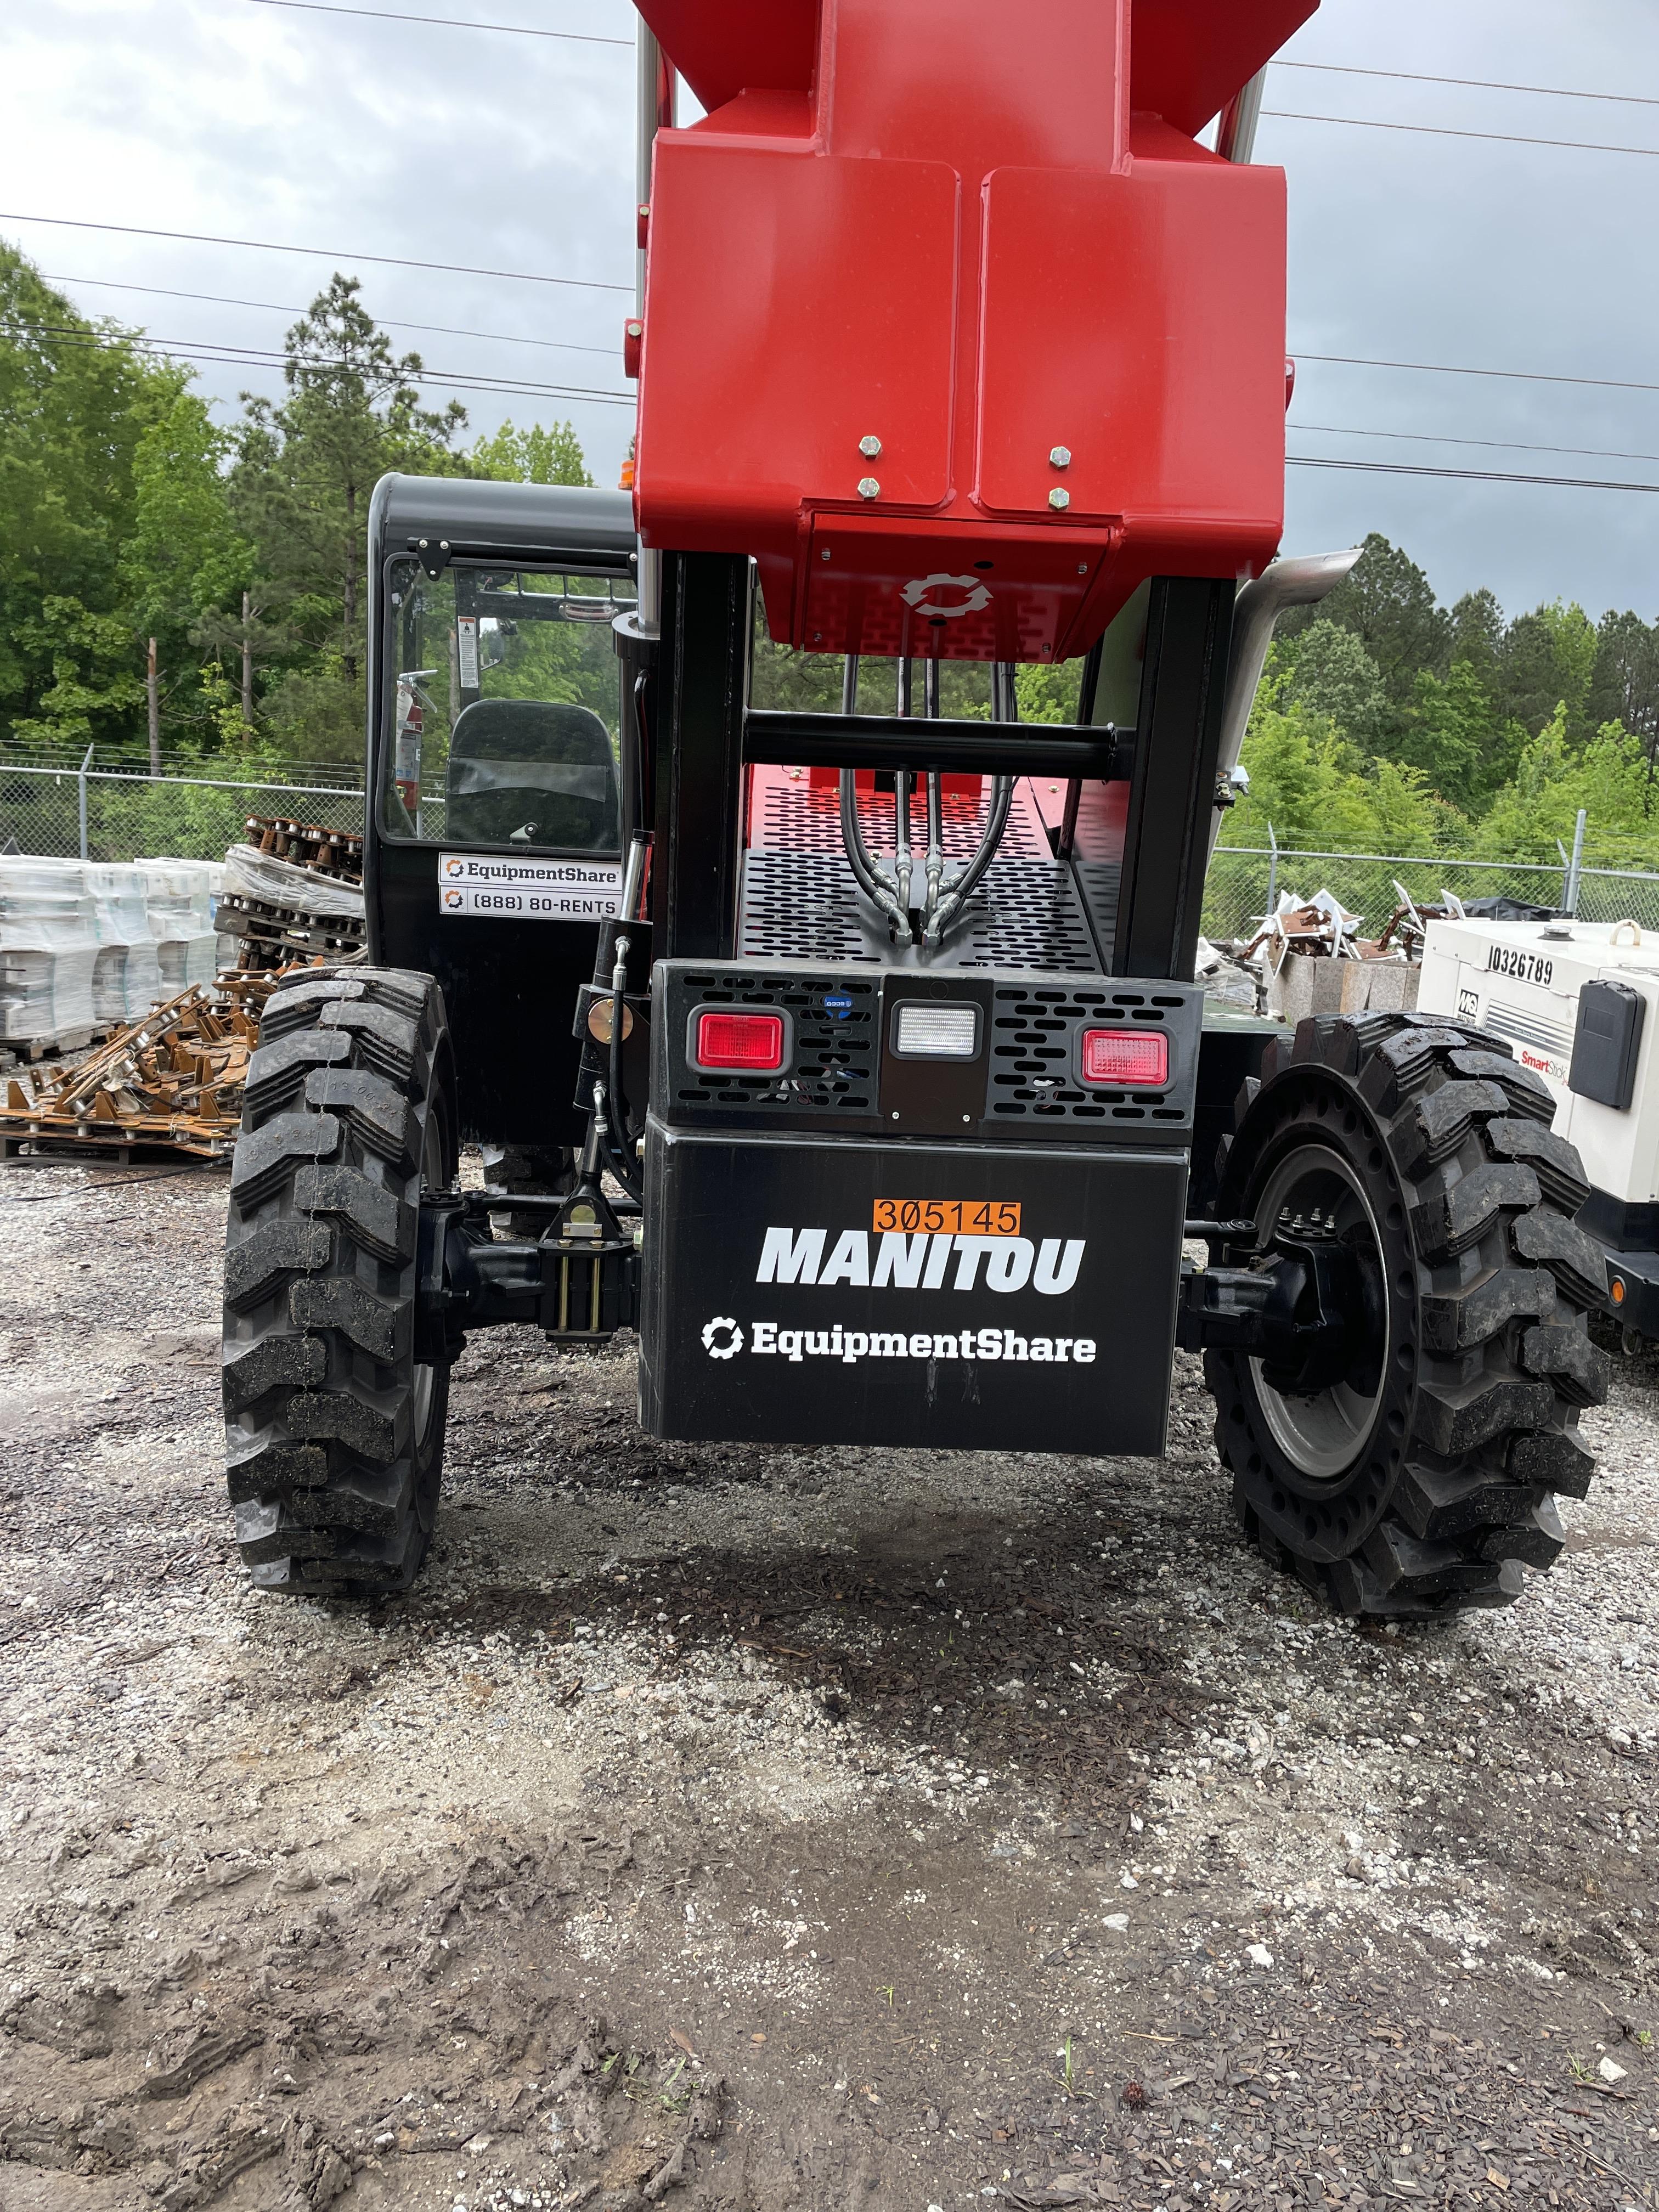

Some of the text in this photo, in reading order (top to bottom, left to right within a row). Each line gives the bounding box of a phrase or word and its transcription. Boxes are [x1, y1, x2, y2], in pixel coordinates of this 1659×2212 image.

[467, 862, 617, 883] EquipmentShare
[475, 894, 616, 913] (888) 80-RENTS
[1488, 945, 1553, 985] 10326789
[1459, 989, 1479, 1017] MQ
[1521, 1051, 1566, 1079] SmartStick
[877, 1200, 1018, 1233] 305145
[755, 1227, 1086, 1295] MANITOU
[751, 1323, 1096, 1363] EquipmentShare
